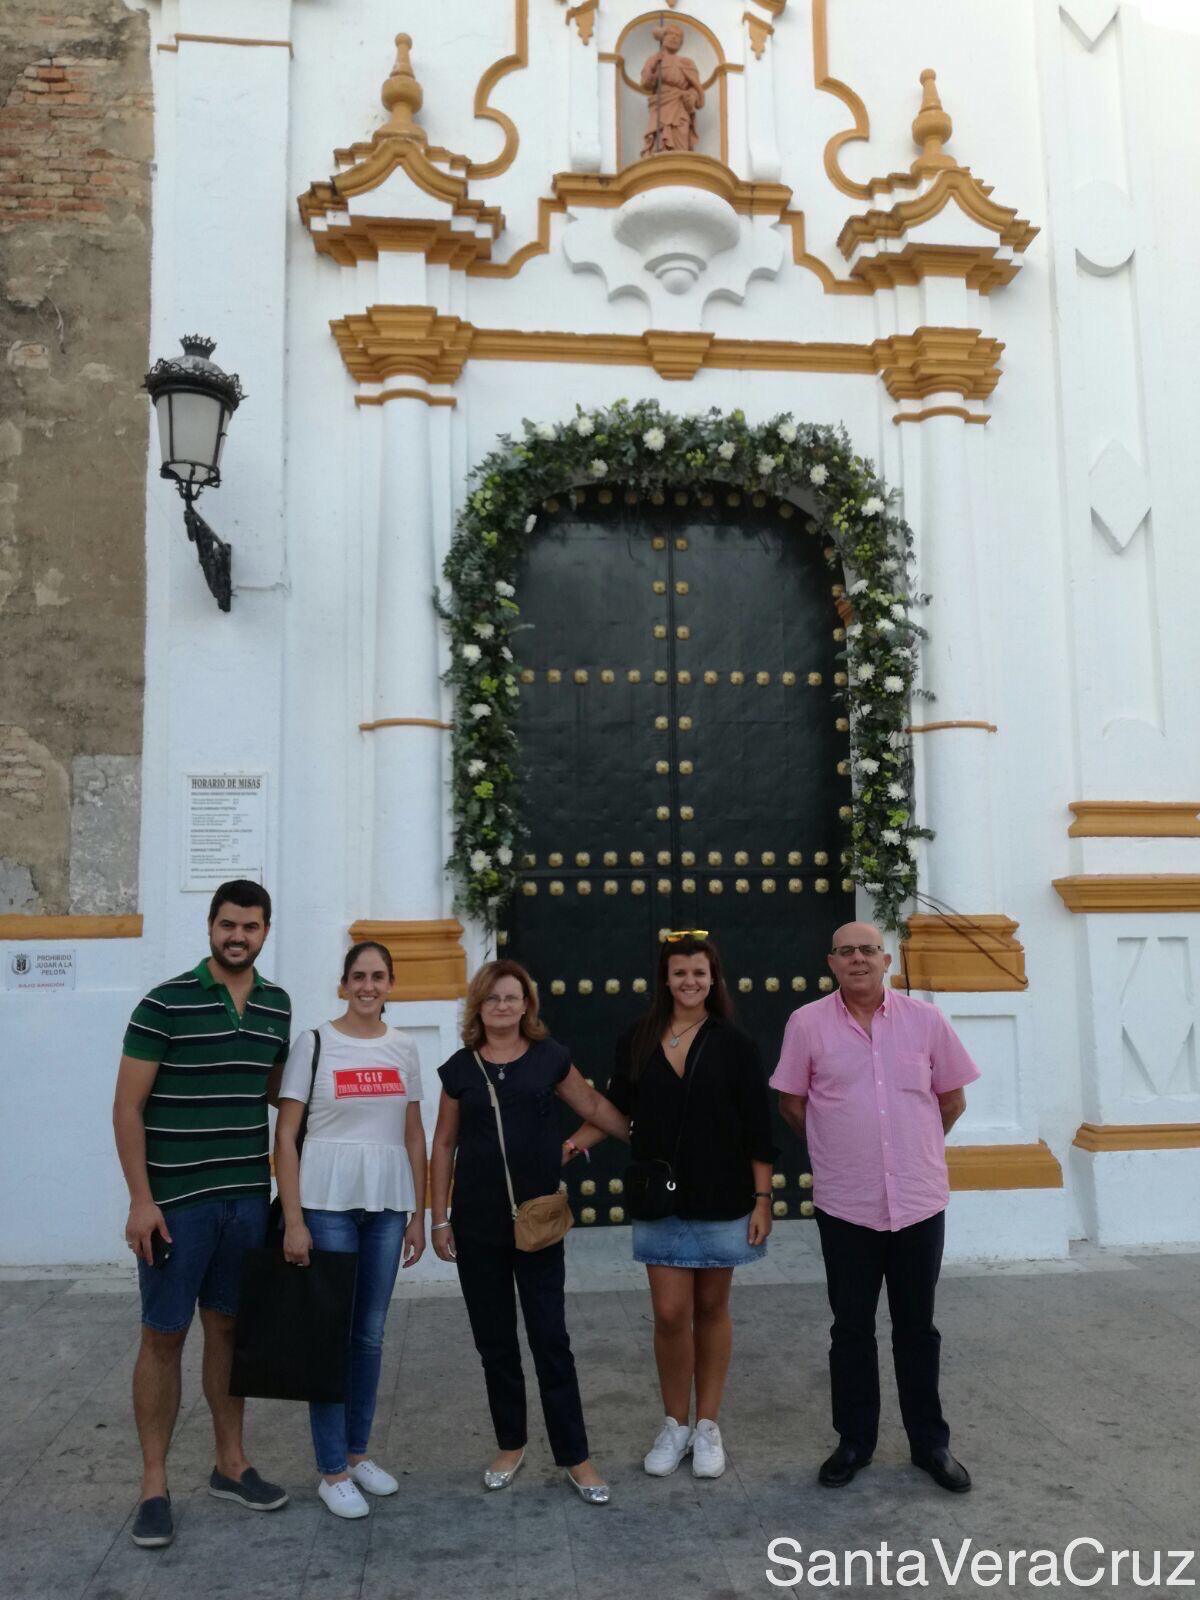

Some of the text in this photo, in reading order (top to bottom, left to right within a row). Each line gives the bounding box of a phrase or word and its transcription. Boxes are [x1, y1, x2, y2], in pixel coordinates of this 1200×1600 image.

[192, 779, 261, 789] HORARIO DE MISAS
[356, 1072, 383, 1083] TGIF
[338, 1084, 359, 1094] THANK
[360, 1084, 373, 1093] GOD
